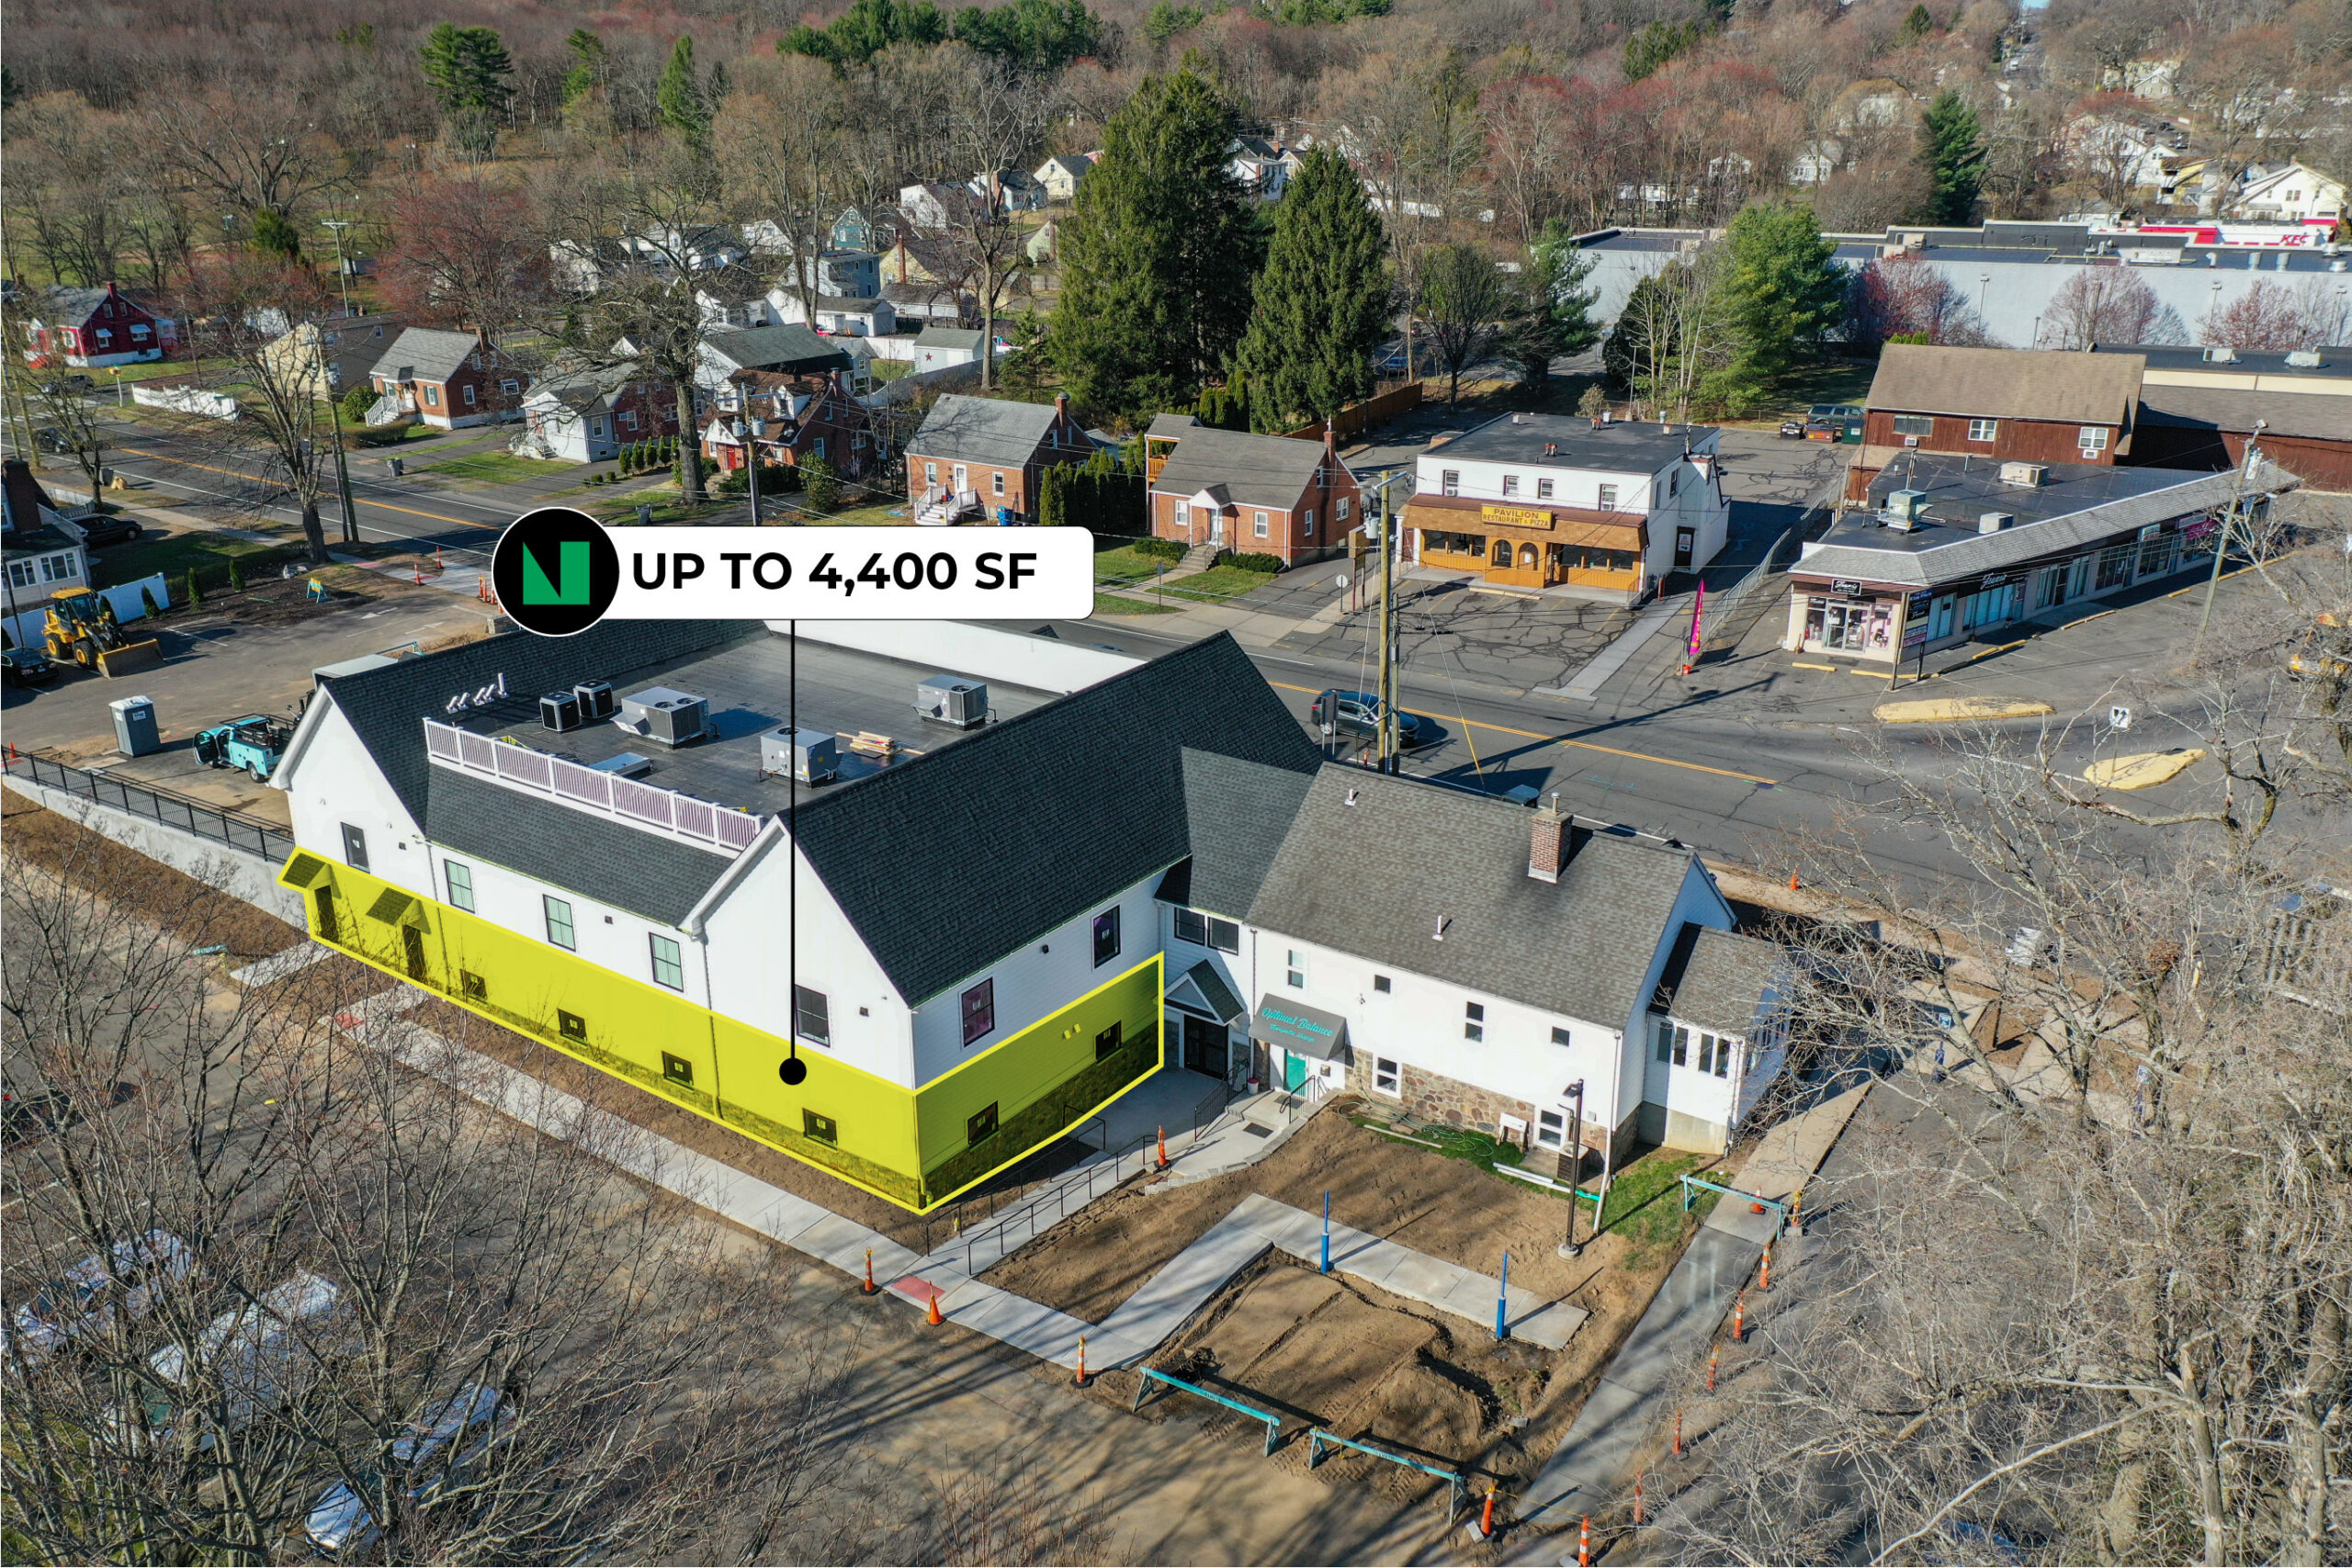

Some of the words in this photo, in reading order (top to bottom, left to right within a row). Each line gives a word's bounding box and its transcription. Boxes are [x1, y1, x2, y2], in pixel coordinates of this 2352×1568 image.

[2280, 235, 2309, 243] KFC
[1494, 508, 1539, 519] PAVILION
[1483, 514, 1522, 525] RESTAURANT
[1261, 1007, 1299, 1025] Optimal
[1297, 1018, 1334, 1037] Balance
